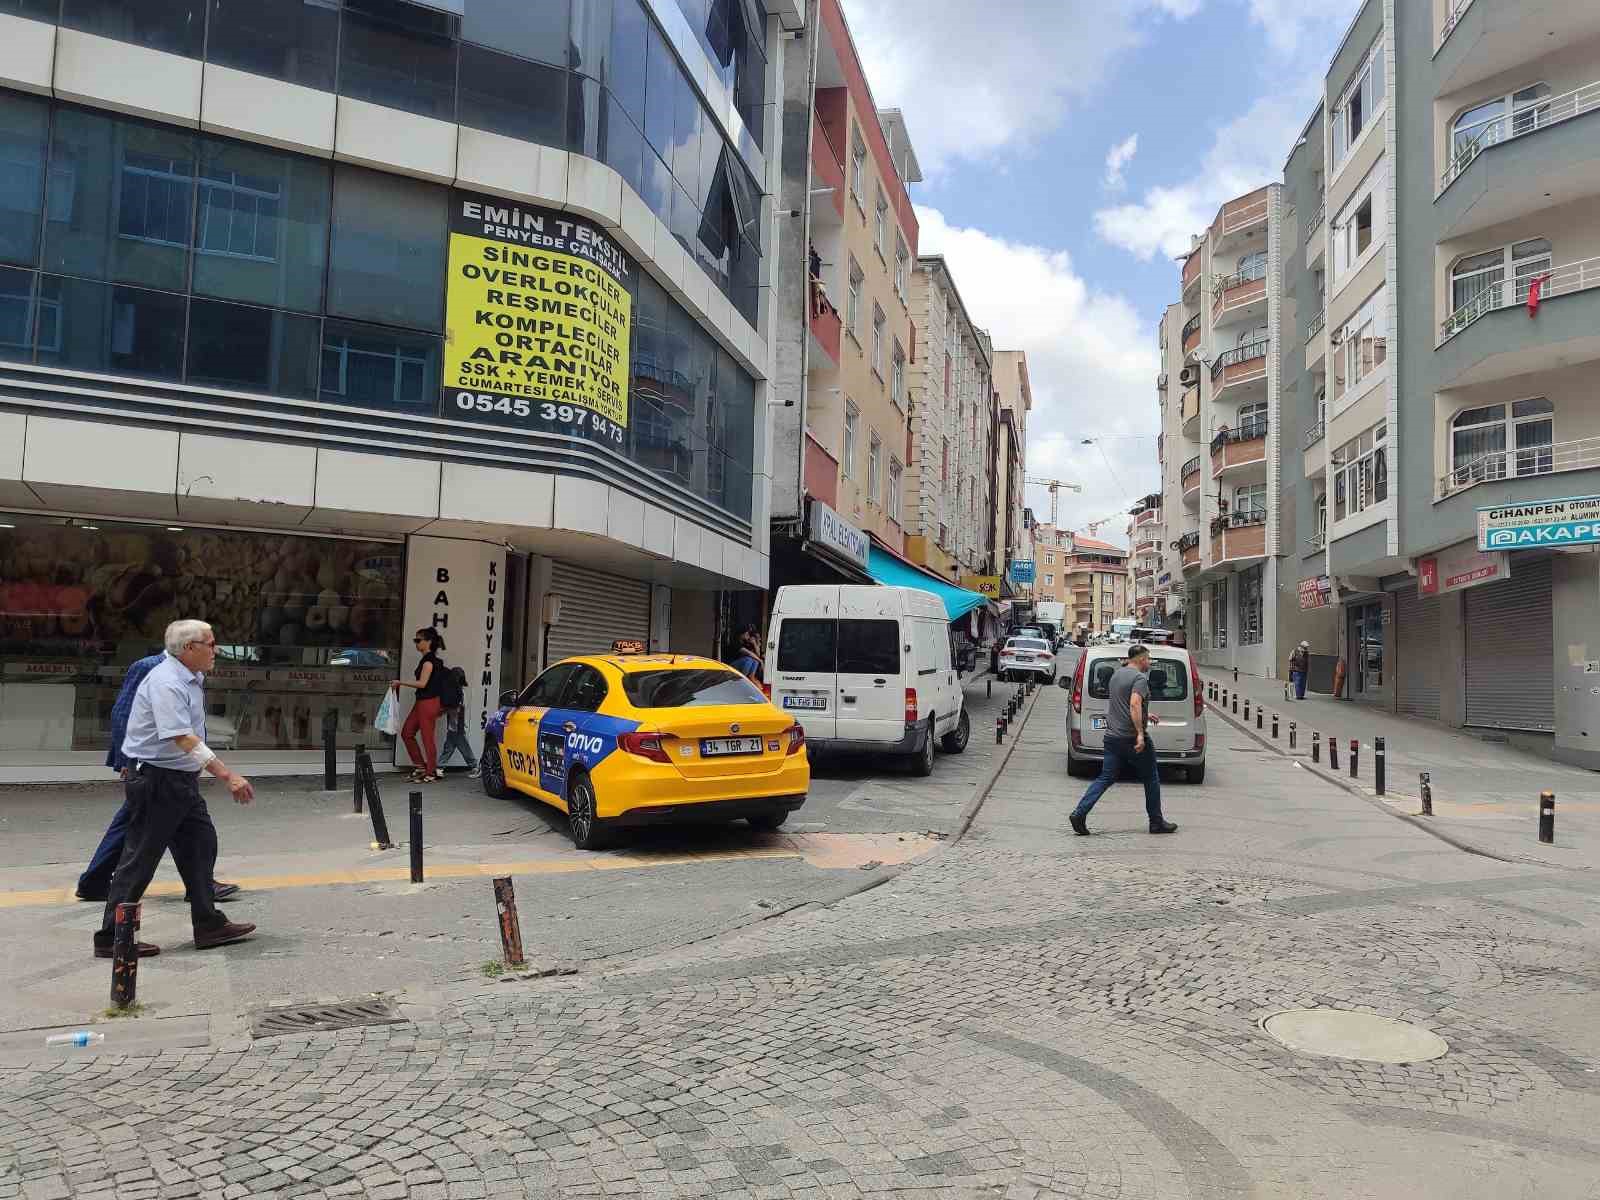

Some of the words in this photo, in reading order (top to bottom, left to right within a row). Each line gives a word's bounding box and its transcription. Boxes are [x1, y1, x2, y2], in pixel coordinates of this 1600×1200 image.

[462, 201, 544, 232] EMİN
[483, 223, 564, 249] PENYEDE
[483, 246, 621, 304] SİNGERCİLER
[462, 264, 626, 329] OVERLOKÇULAR
[469, 346, 620, 397] ARANIYOR
[495, 332, 612, 375] ORTACILAR
[458, 377, 547, 397] CUMARTESİ
[461, 361, 500, 378] SSK
[507, 368, 516, 379] +
[523, 370, 585, 392] YEMEK
[456, 392, 531, 417] 0545
[540, 403, 588, 425] 397
[591, 415, 607, 436] 94
[609, 426, 623, 443] 73
[481, 561, 497, 730] KURUYEMİŞ
[507, 749, 526, 775] TGR
[526, 754, 537, 777] 21
[707, 741, 719, 753] 34
[726, 740, 742, 752] TGR
[750, 739, 760, 751] 21
